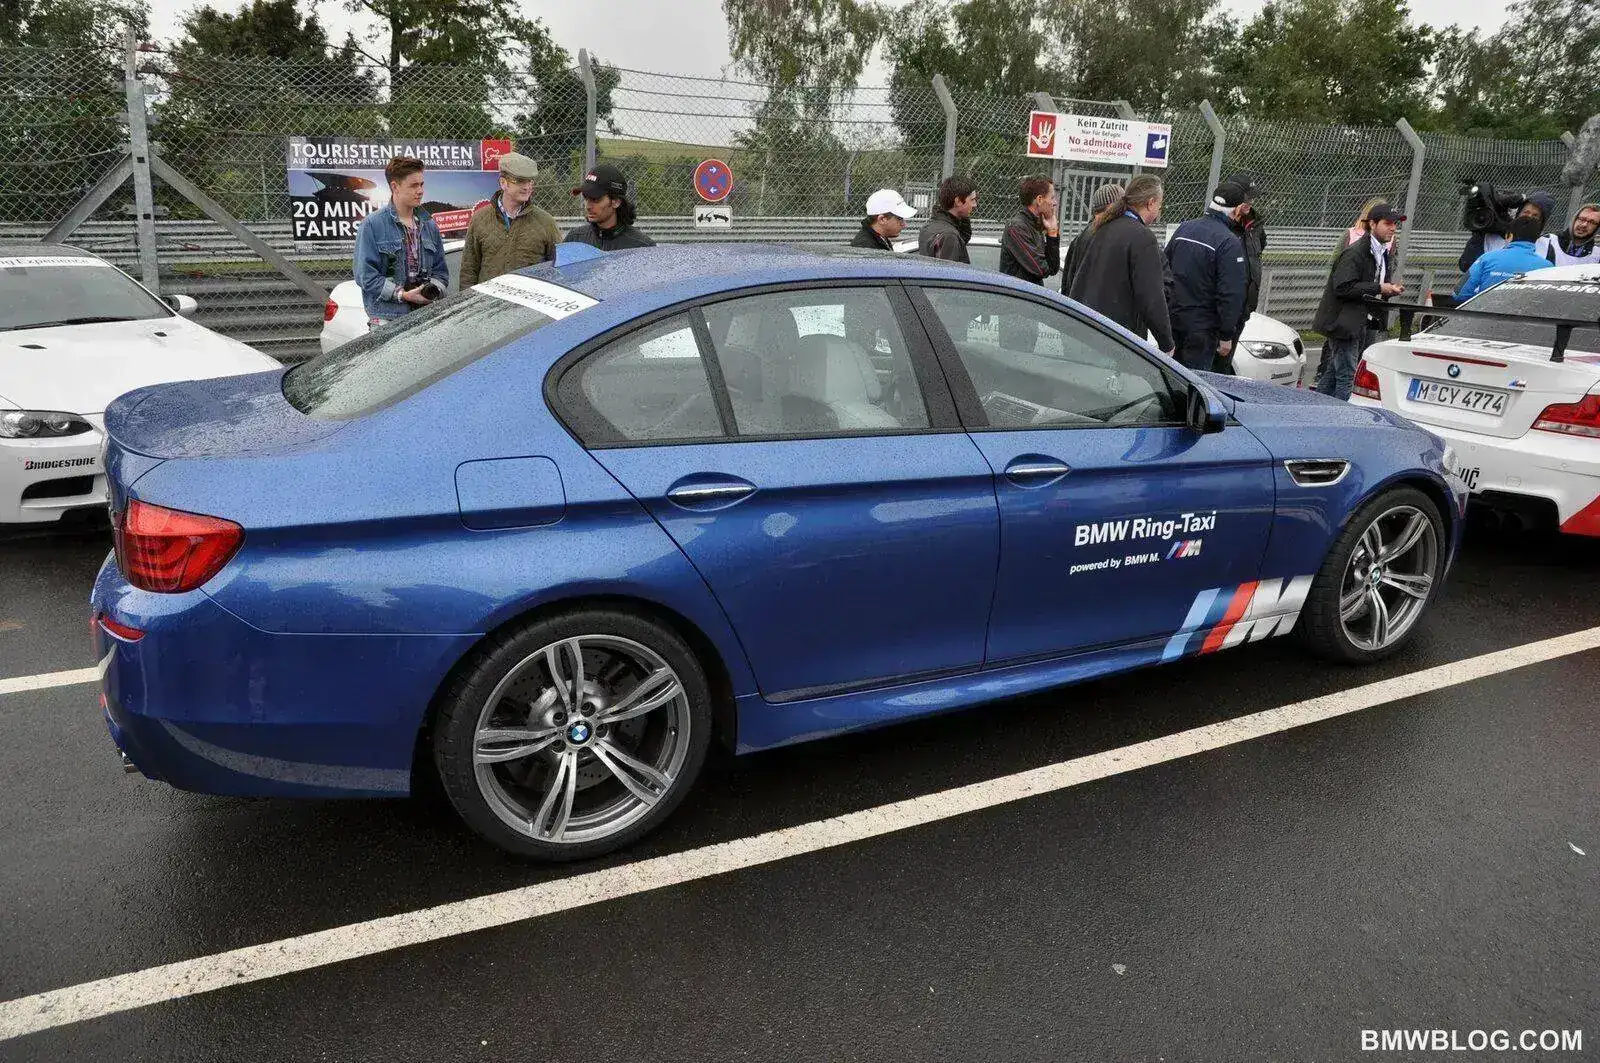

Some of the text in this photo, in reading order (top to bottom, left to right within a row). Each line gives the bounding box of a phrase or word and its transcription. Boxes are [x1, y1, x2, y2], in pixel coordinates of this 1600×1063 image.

[1077, 118, 1129, 131] Kein Zutritt
[290, 142, 473, 160] TOURISTENFAHRTEN
[1068, 135, 1132, 150] No admittance
[1117, 151, 1129, 159] only
[293, 201, 319, 218] 20
[296, 220, 361, 237] FAHRS
[1417, 382, 1504, 413] M CY 4774
[24, 457, 96, 470] BRIDGESTONE
[1074, 510, 1217, 546] BMW Ring-Taxi
[1069, 552, 1160, 575] powered by BMW M.
